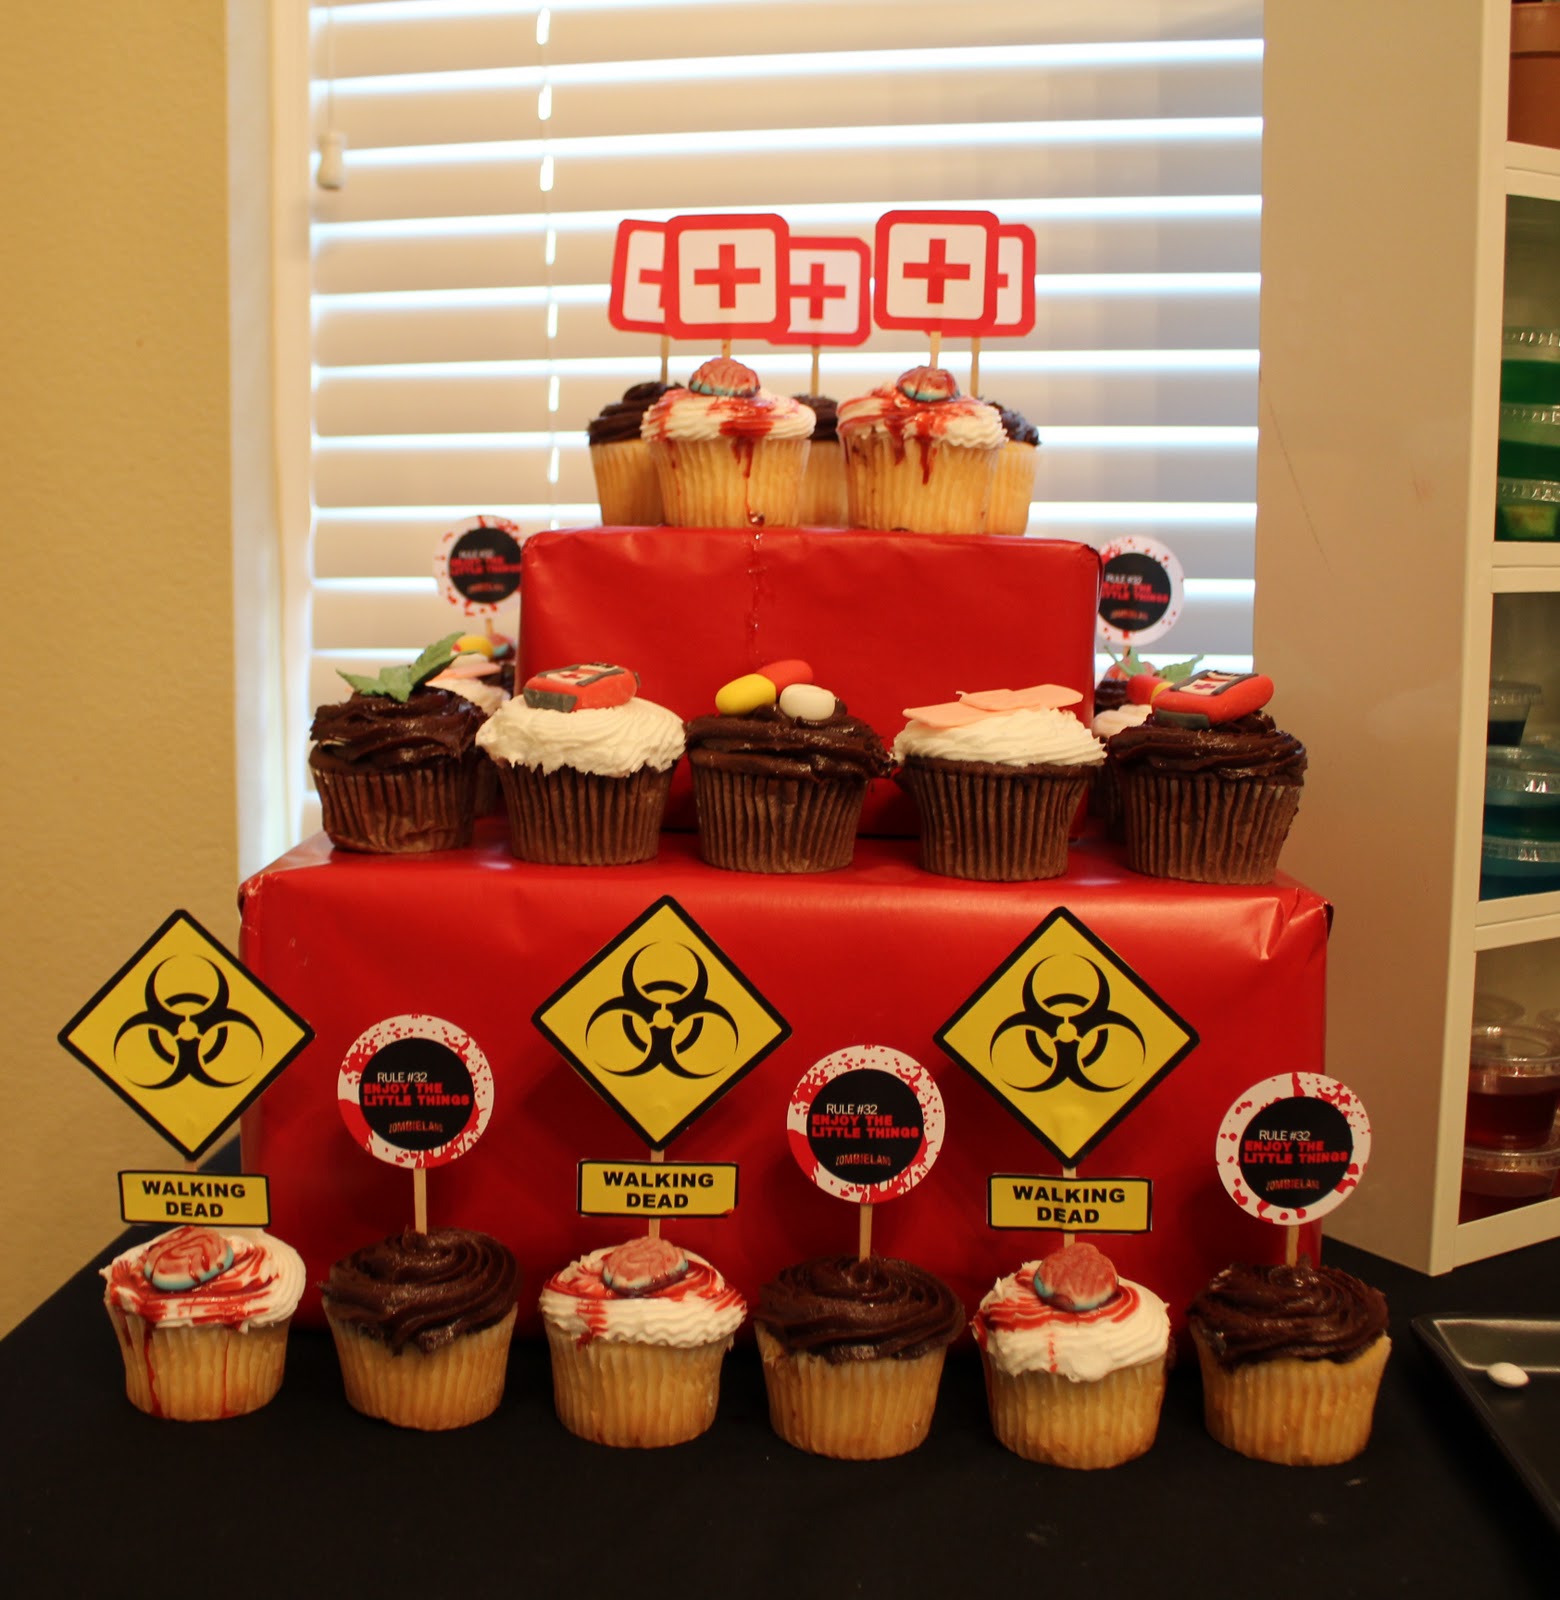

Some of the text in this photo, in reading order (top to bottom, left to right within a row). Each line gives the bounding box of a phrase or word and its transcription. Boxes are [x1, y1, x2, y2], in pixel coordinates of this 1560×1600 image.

[377, 1071, 428, 1083] RULE #32
[363, 1083, 443, 1094] ENJOY THE
[364, 1094, 470, 1107] LITTLE THINGS
[826, 1103, 878, 1115] RULE #32
[812, 1114, 893, 1126] ENJOY THE
[812, 1126, 920, 1139] LITTLE THINGS
[1259, 1129, 1311, 1141] RULE #32
[1244, 1140, 1325, 1152] ENJOY THE
[1243, 1151, 1349, 1164] LITTLE THINGS
[603, 1171, 714, 1188] WALKING
[142, 1180, 246, 1198] WALKING
[1012, 1185, 1126, 1203] WALKING
[626, 1193, 689, 1209] DEAD
[165, 1201, 224, 1218] DEAD
[1037, 1206, 1100, 1224] DEAD
